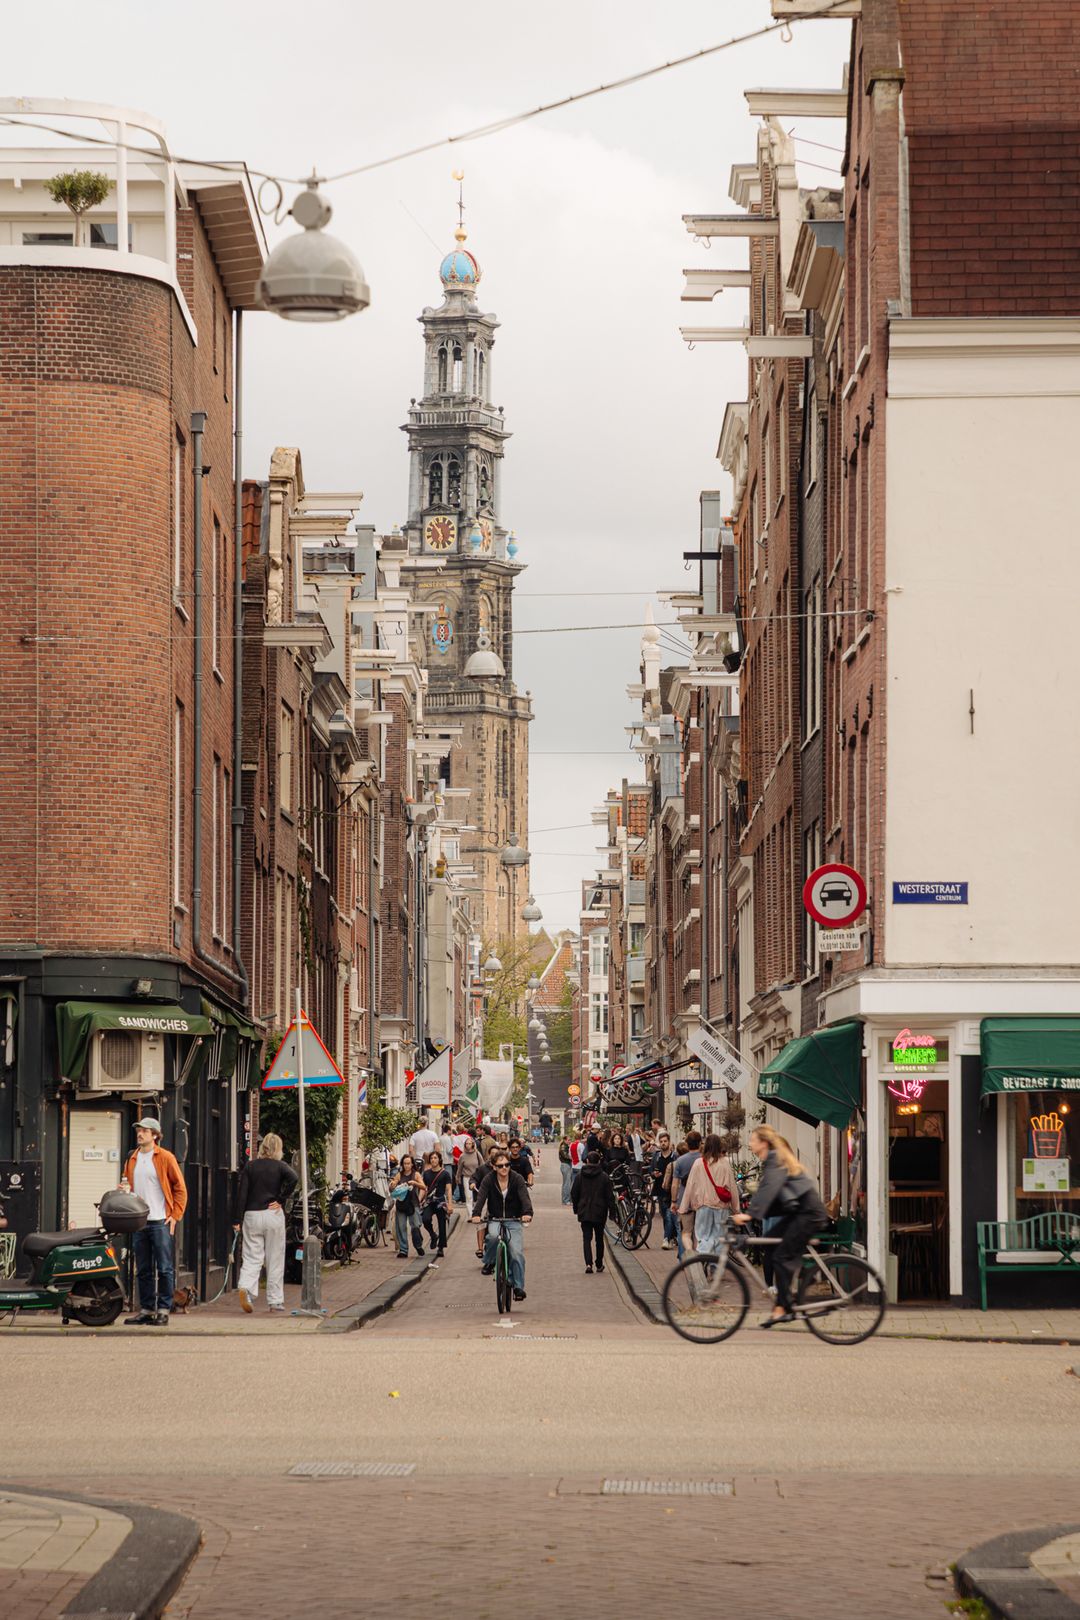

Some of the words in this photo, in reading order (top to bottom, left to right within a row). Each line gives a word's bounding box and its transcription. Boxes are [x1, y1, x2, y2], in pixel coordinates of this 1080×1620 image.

[899, 884, 961, 894] WESTERSTRAAT
[118, 1017, 189, 1031] SANDWICHES
[291, 1045, 296, 1057] 1
[678, 1081, 708, 1089] GLITCH
[1003, 1077, 1049, 1089] BEVERAGE
[72, 1259, 97, 1270] felyx
